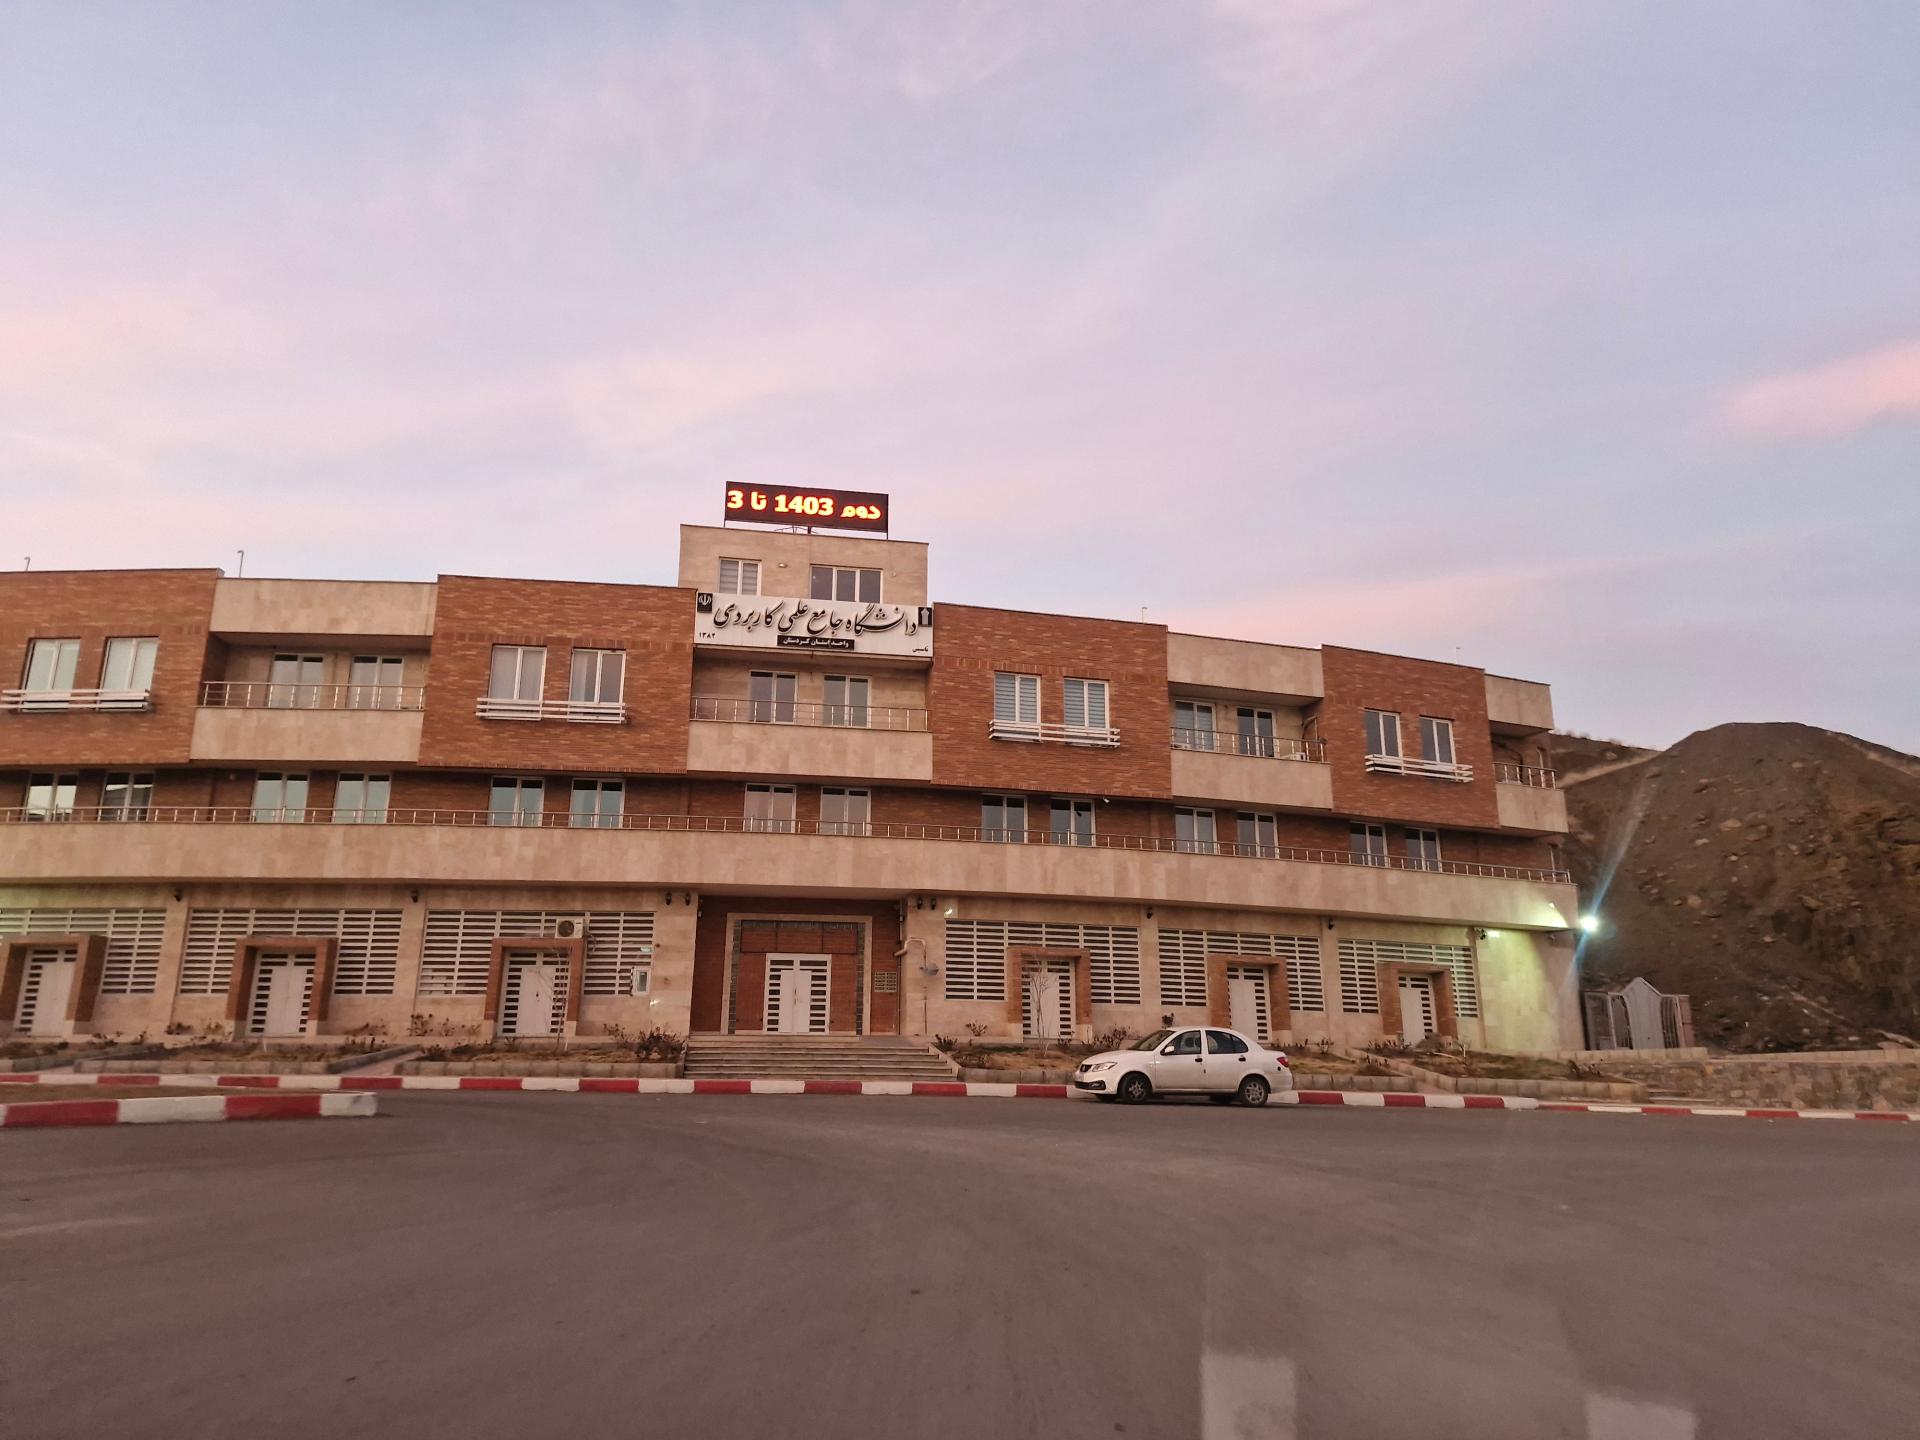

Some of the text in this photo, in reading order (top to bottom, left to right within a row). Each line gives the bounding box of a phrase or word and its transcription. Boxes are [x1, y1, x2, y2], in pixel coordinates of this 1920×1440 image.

[727, 490, 743, 508] 3
[774, 494, 834, 516] 1403
[840, 504, 881, 520] دوم
[713, 600, 917, 635] دانشگاه جامع علمی کاربردی
[783, 637, 849, 648] واحد استان کردستان
